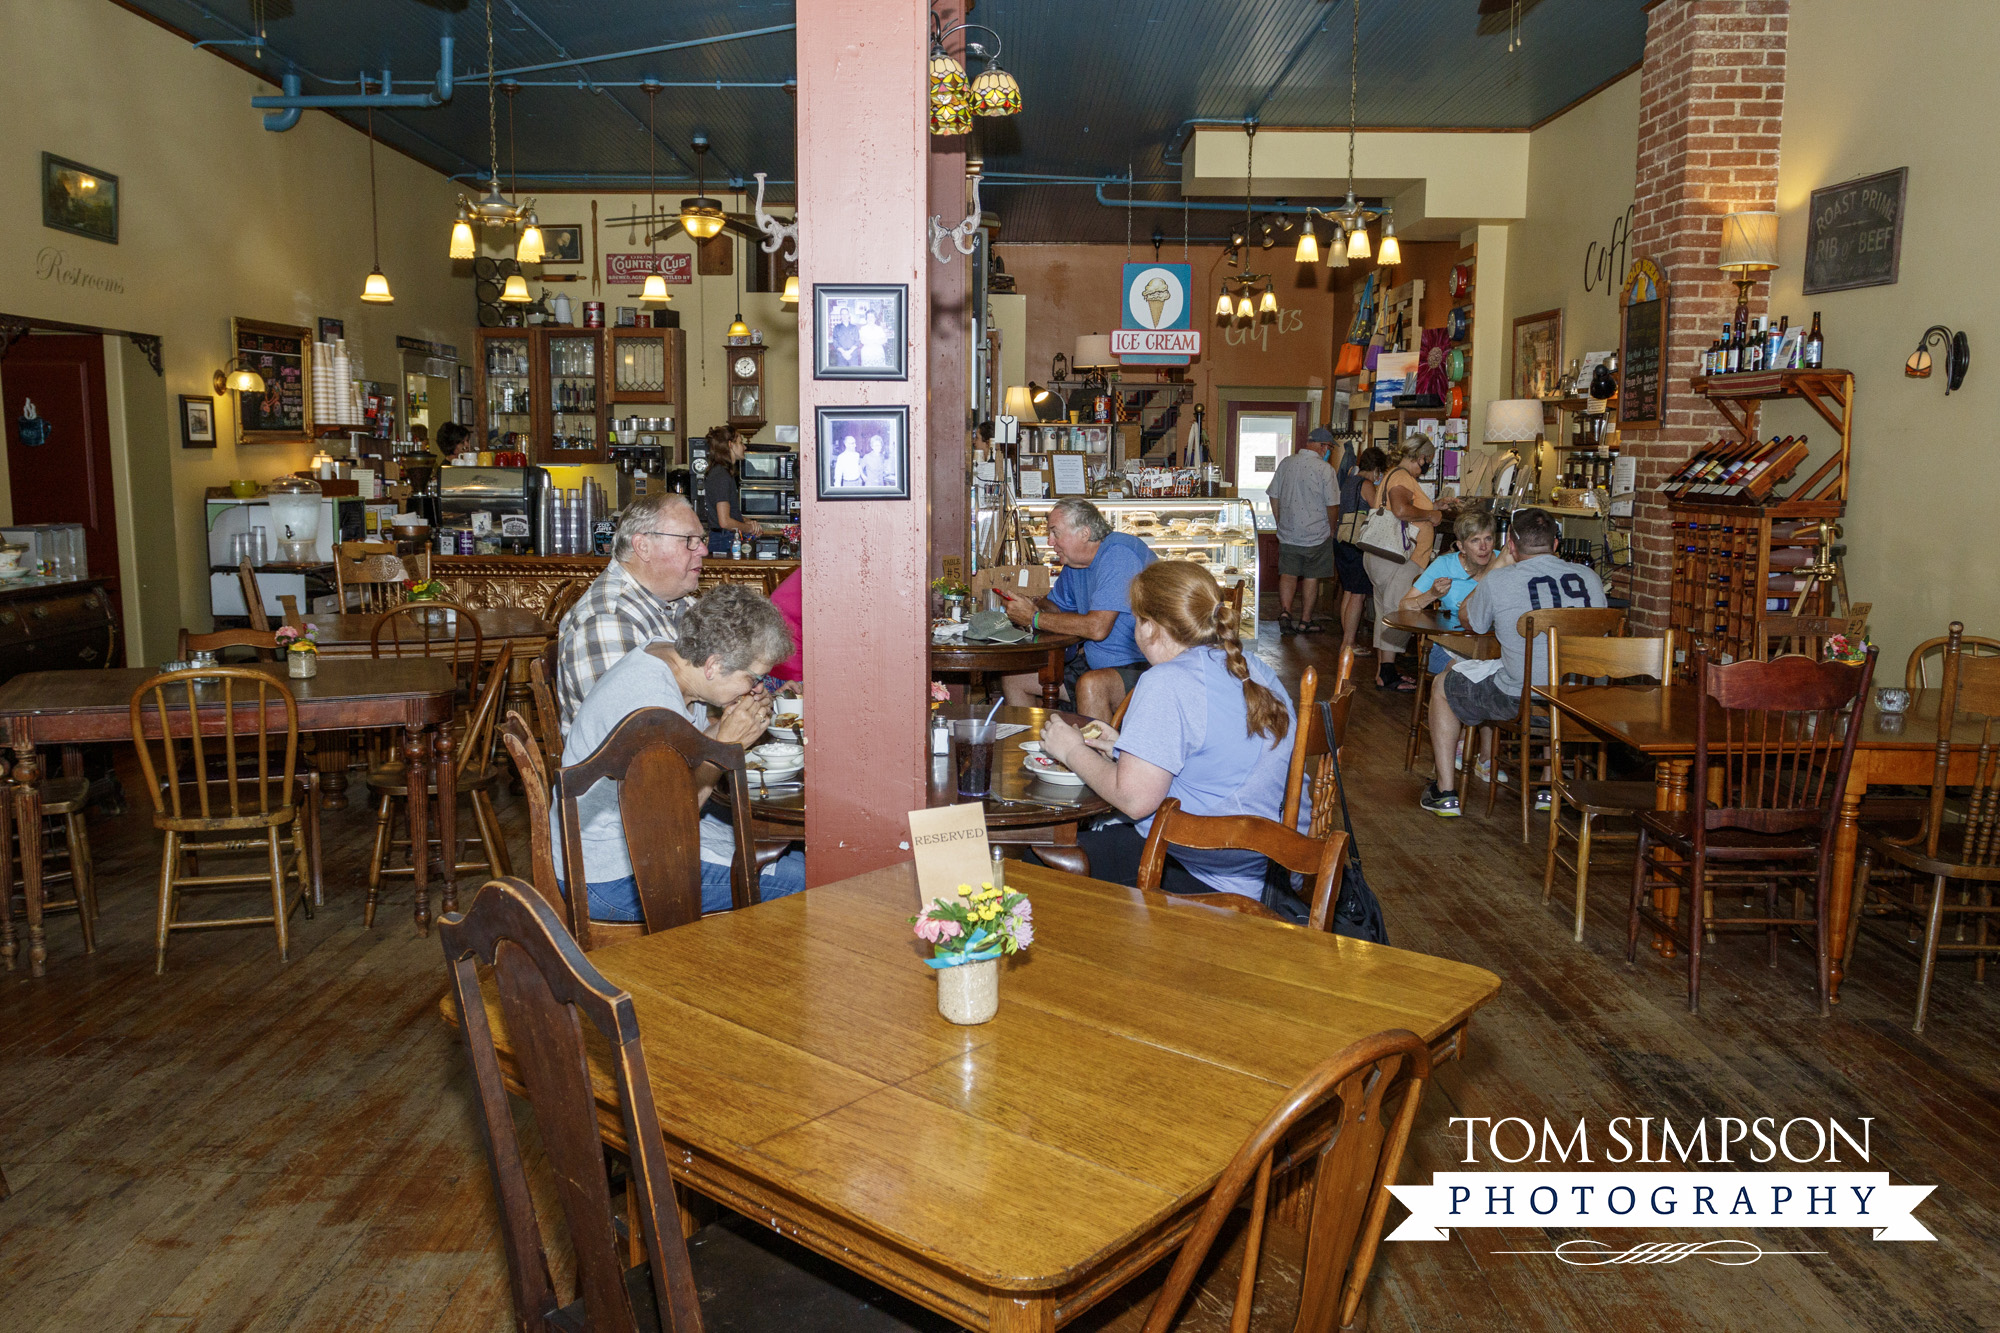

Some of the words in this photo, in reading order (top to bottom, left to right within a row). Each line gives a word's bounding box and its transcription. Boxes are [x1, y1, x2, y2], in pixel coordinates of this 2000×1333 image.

[1815, 190, 1857, 235] ROAST
[1860, 188, 1897, 223] PRIME
[1814, 236, 1838, 261] RIB
[1858, 225, 1894, 254] BEEF
[36, 246, 125, 294] Restrooms
[1624, 260, 1641, 291] COLD
[1641, 259, 1660, 286] BEER
[1116, 333, 1140, 350] ICE
[1145, 333, 1196, 351] CREAM
[1848, 619, 1863, 635] #2
[914, 827, 984, 846] RESERVED
